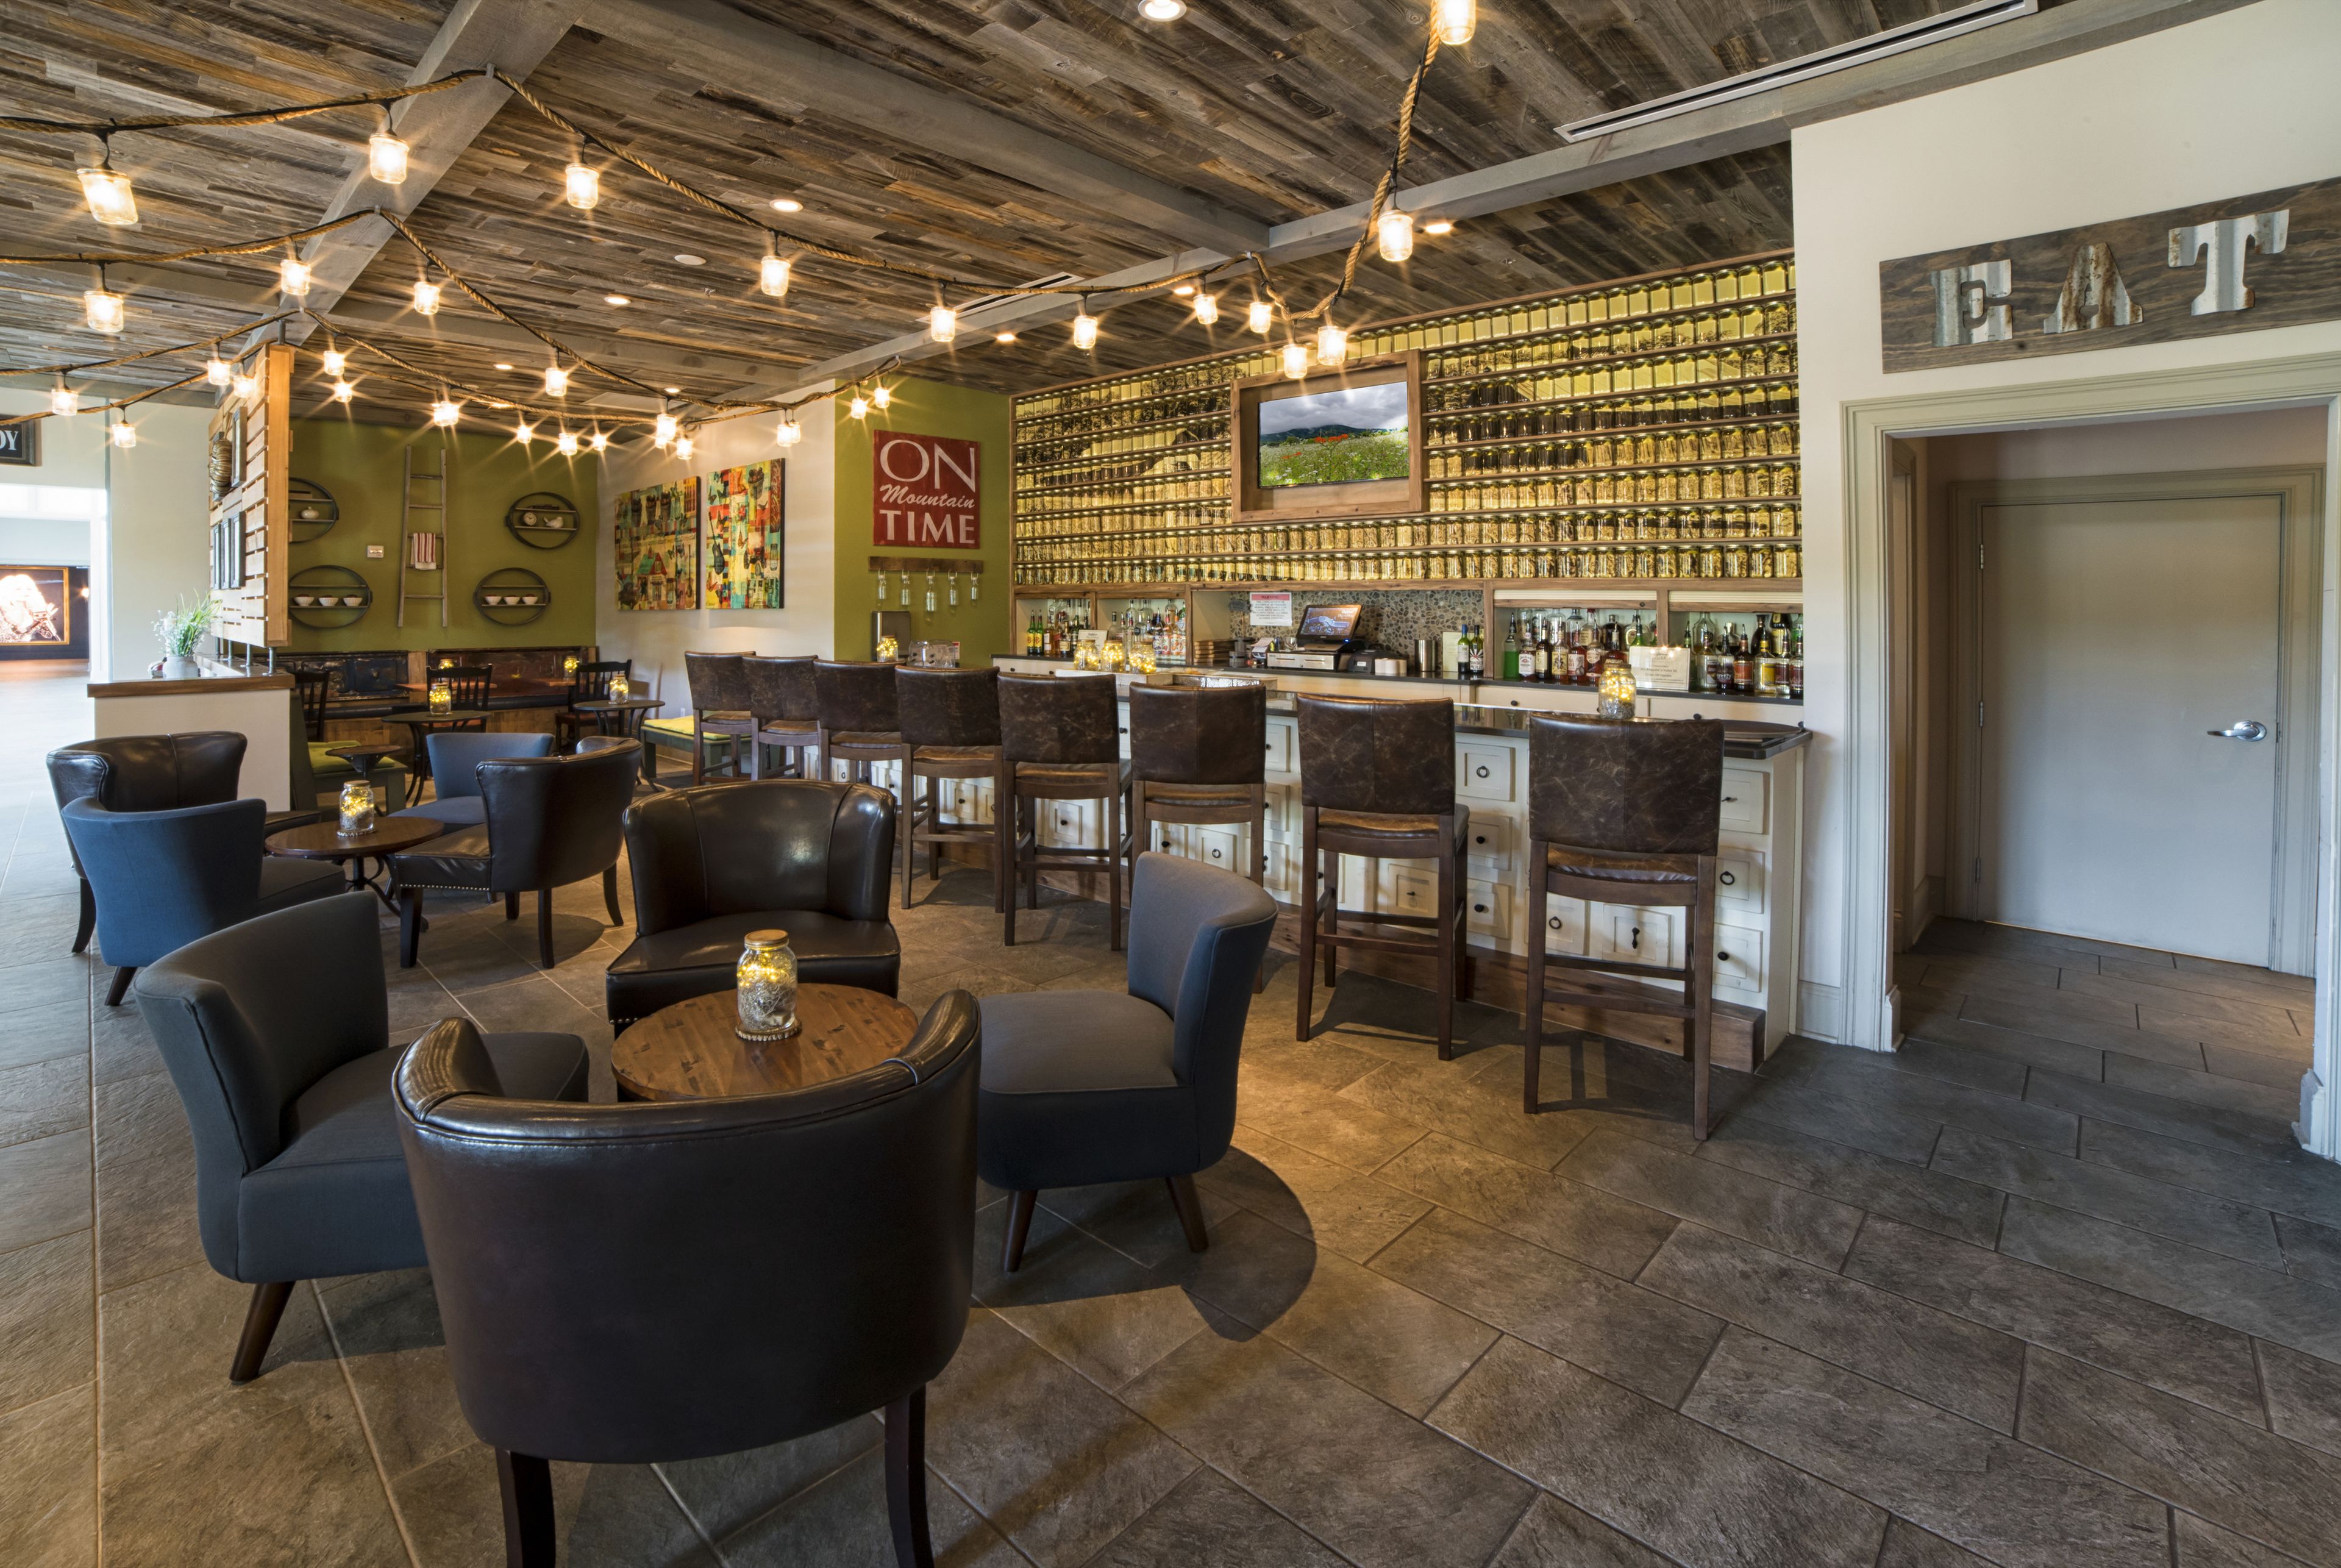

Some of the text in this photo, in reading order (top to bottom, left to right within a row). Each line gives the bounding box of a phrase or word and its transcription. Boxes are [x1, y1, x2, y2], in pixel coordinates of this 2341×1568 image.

[1930, 208, 2290, 347] EAT
[880, 440, 975, 493] ON
[880, 483, 975, 508] Mountain
[879, 510, 975, 544] TIME
